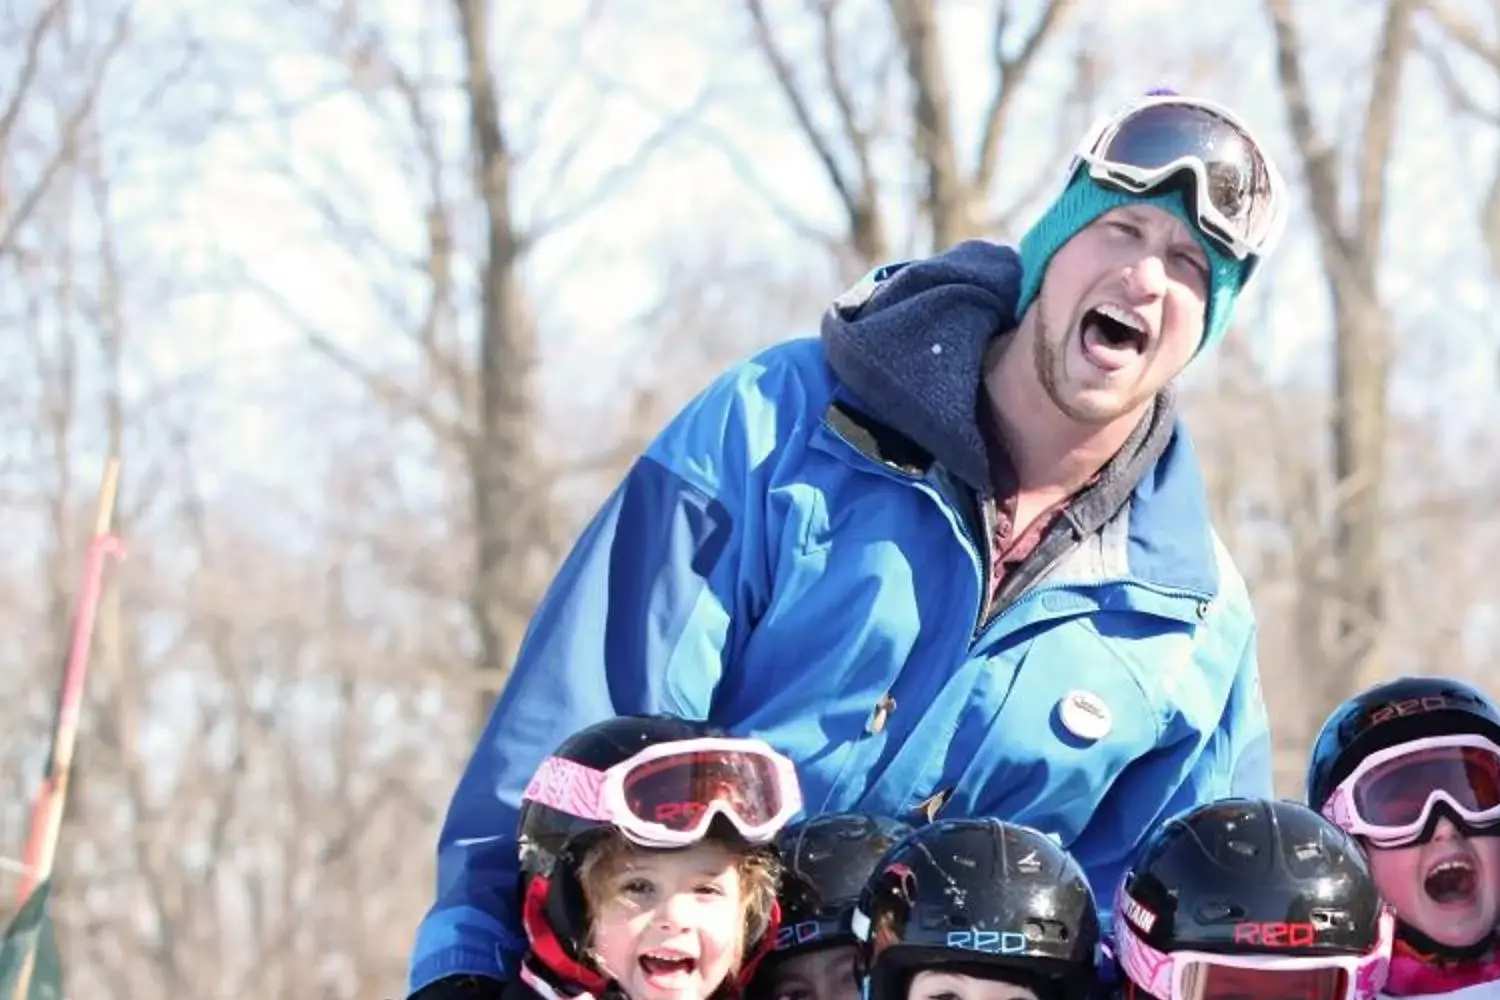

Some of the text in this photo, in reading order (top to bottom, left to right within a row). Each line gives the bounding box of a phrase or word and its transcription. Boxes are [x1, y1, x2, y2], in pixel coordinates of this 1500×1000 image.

[1372, 697, 1447, 725] RED
[947, 931, 1026, 954] RED
[1235, 922, 1316, 946] RED
